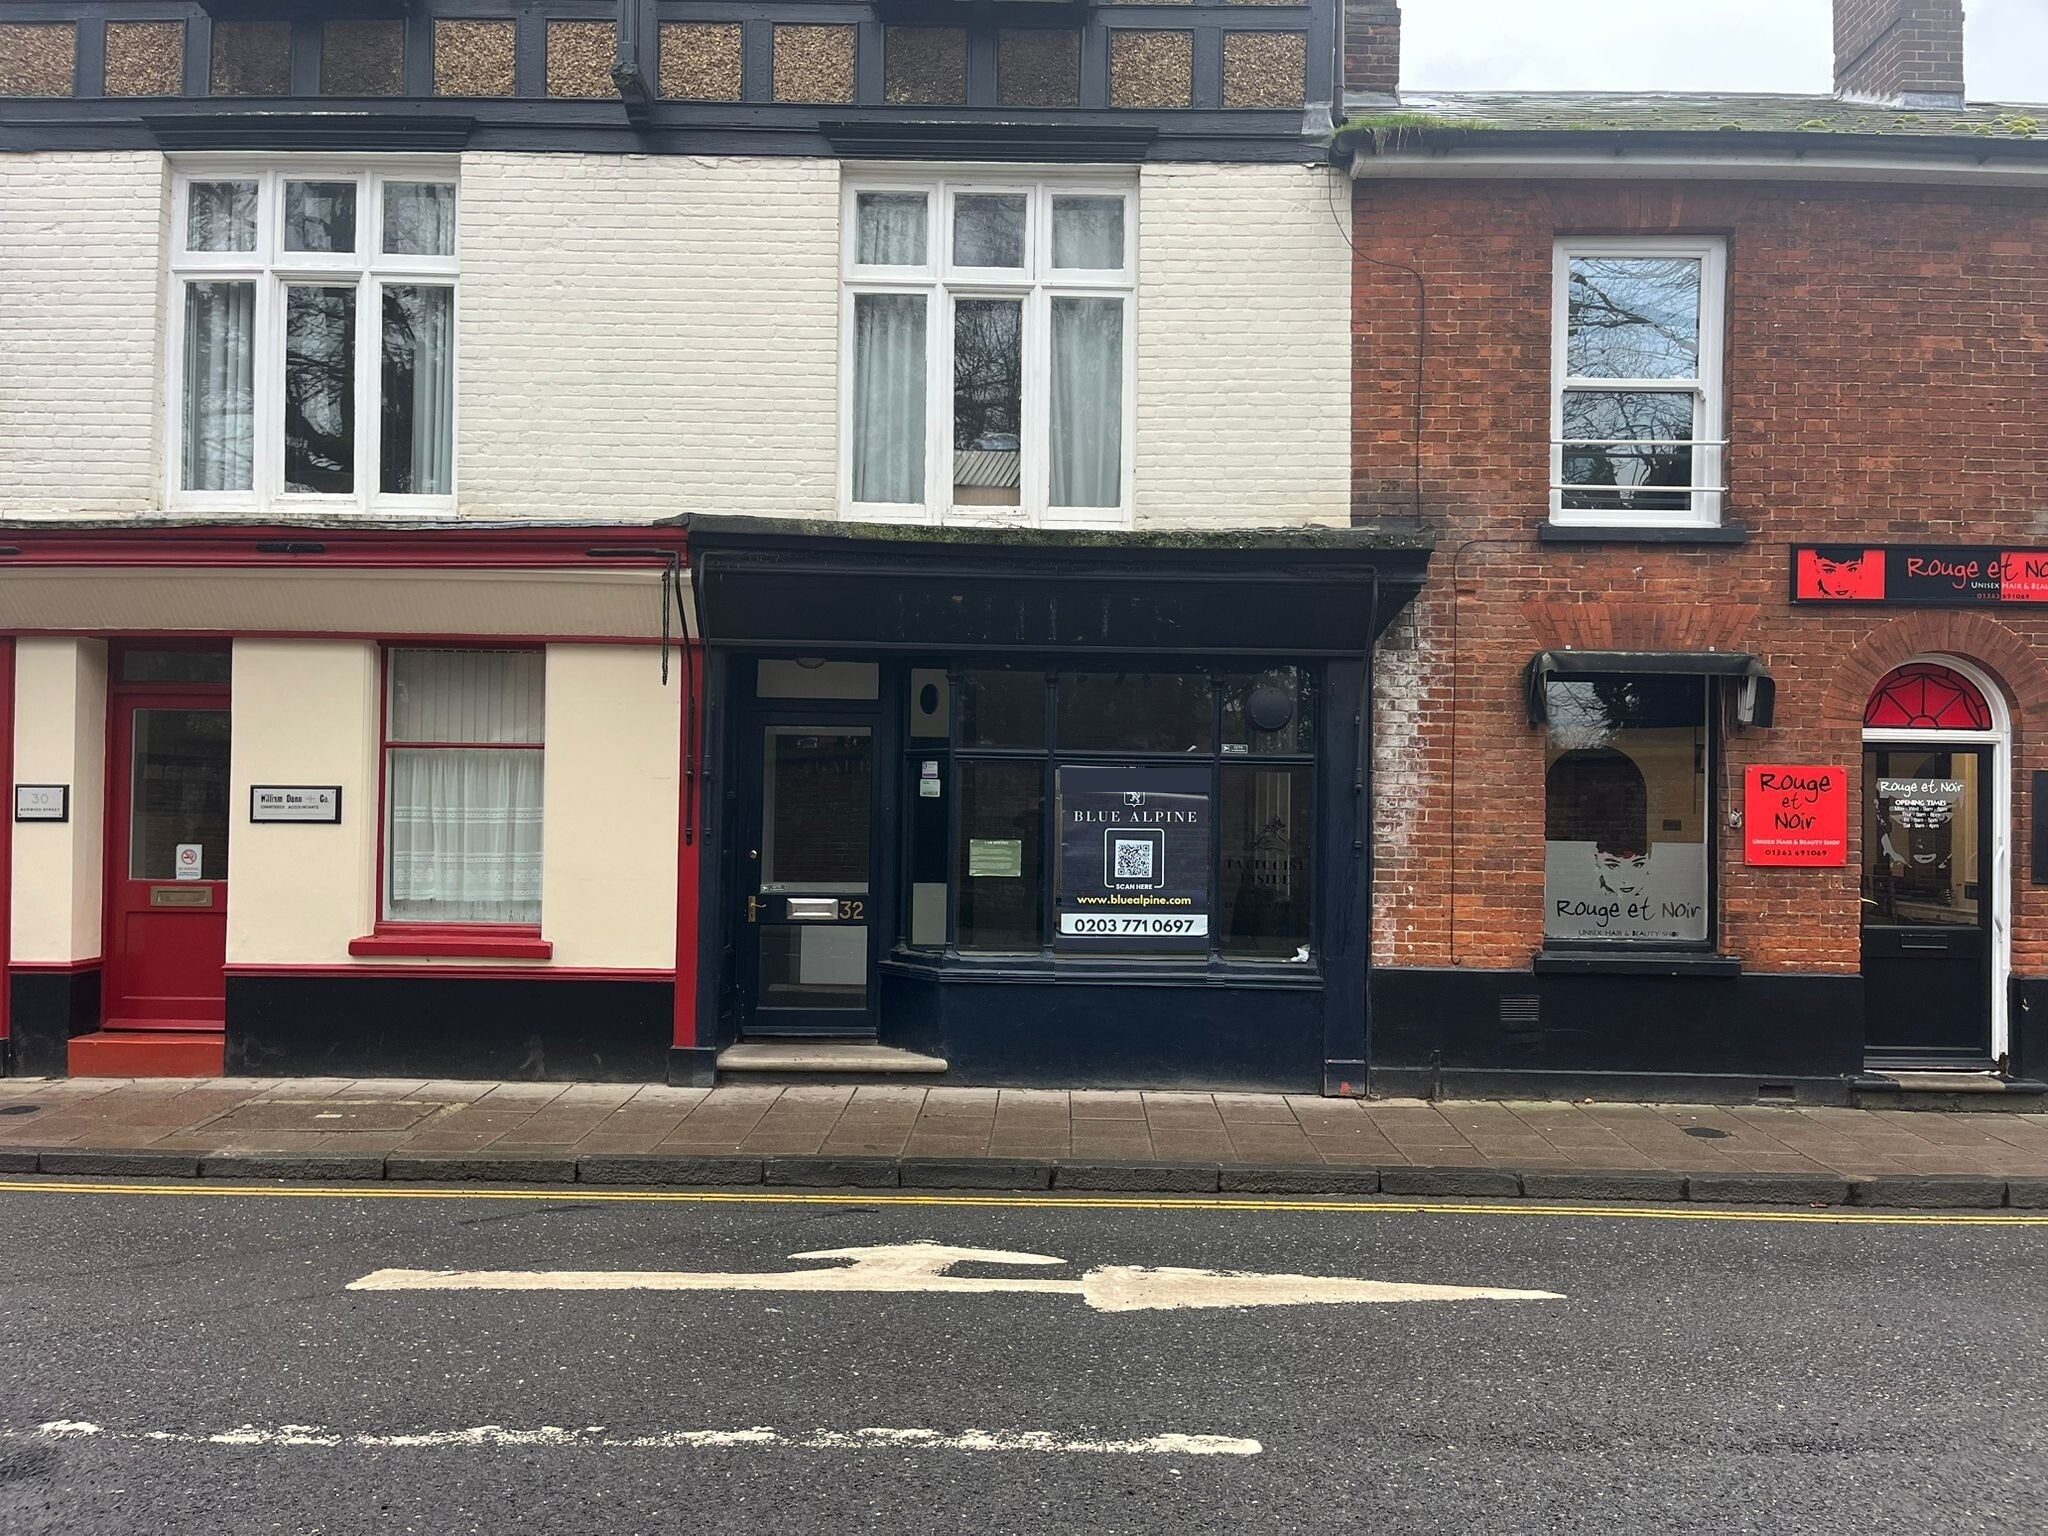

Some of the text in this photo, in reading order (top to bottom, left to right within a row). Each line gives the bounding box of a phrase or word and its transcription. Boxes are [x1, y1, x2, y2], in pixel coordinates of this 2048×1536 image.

[1907, 557, 1980, 589] Rouge
[1987, 554, 2019, 581] et
[1760, 773, 1832, 803] Rouge
[1880, 781, 1918, 798] Rouge
[1921, 779, 1938, 794] et
[31, 793, 49, 804] 30
[1781, 792, 1802, 810] et
[1074, 810, 1198, 823] BLUE ALPINE
[1077, 894, 1192, 907] www.bluealpine.com
[839, 901, 864, 920] 32
[1556, 900, 1621, 928] Rouge
[1627, 897, 1656, 921] et
[1074, 919, 1195, 933] 0203 771 0697
